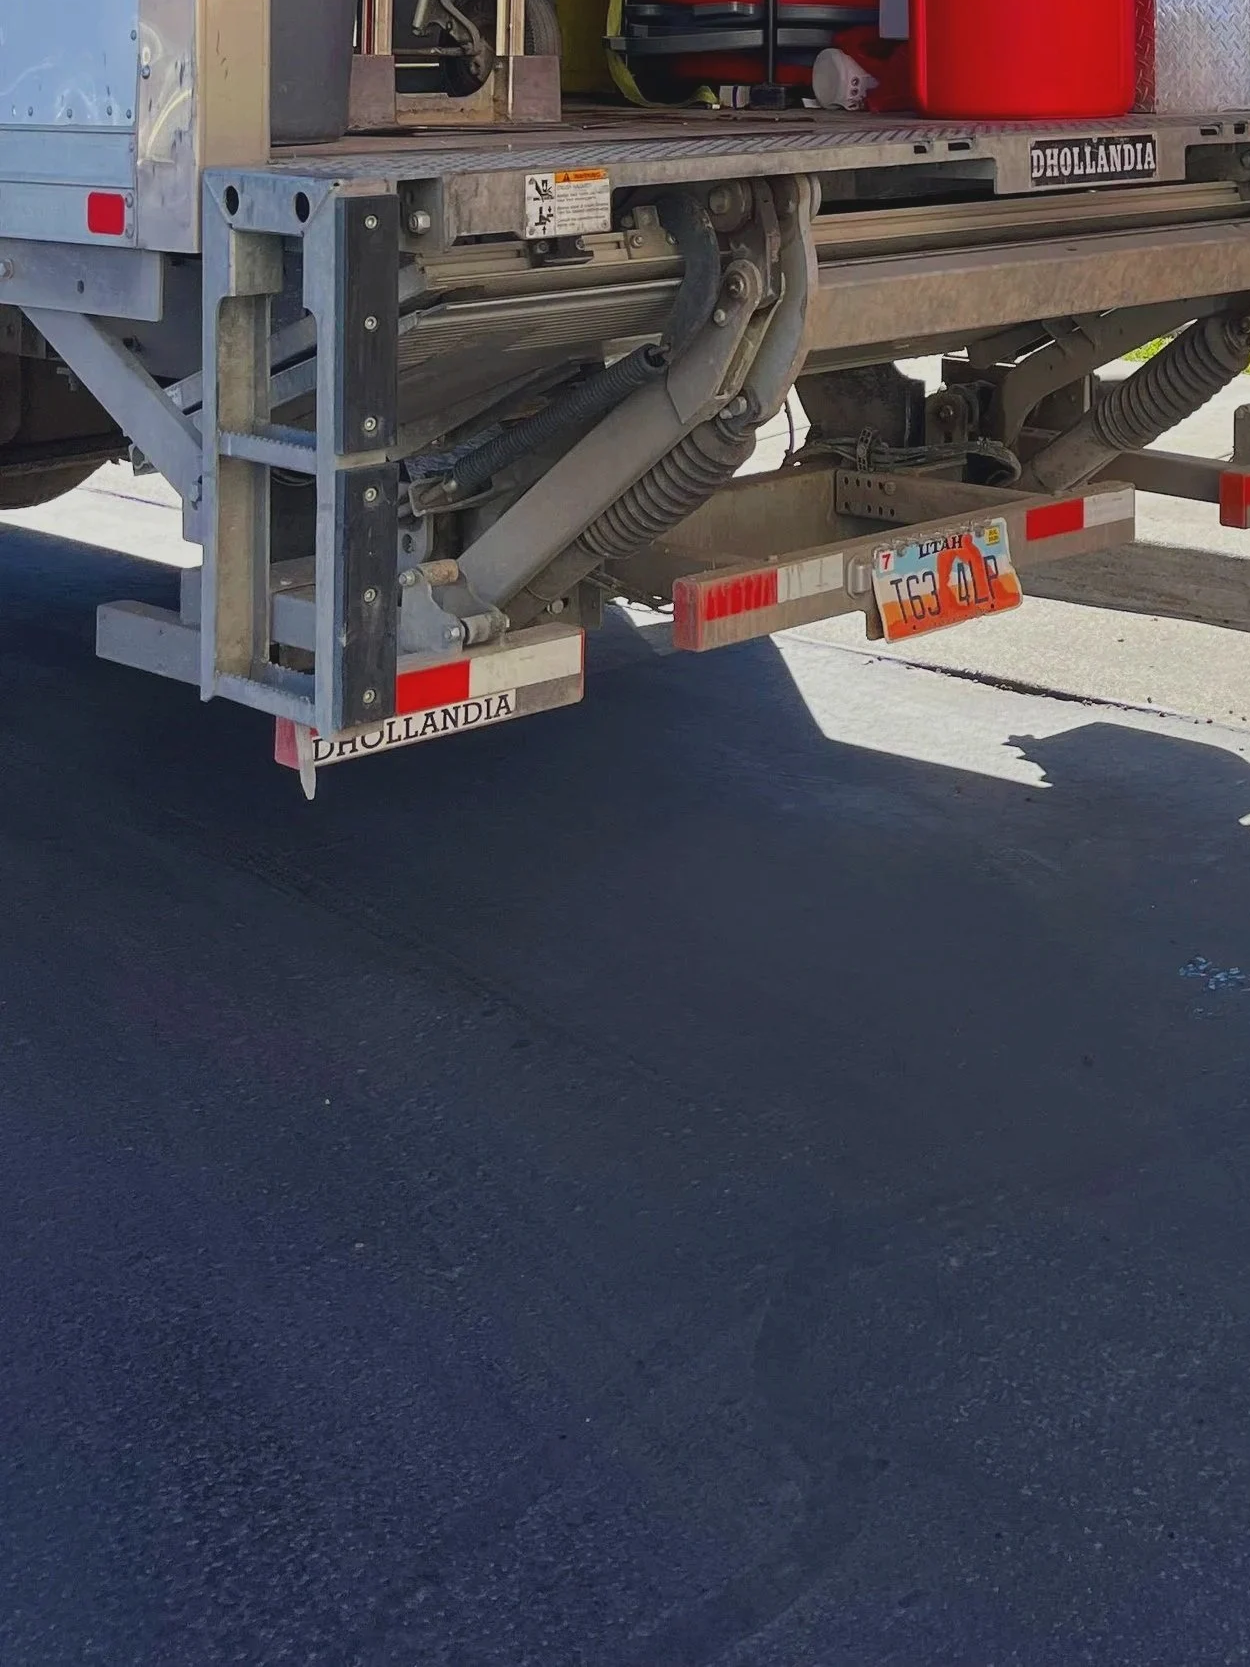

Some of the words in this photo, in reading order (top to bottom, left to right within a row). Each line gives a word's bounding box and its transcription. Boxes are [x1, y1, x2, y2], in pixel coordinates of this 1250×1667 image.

[1031, 142, 1156, 178] DHOLLANDIA
[881, 553, 892, 571] 7
[918, 534, 964, 559] UTAH
[890, 571, 941, 624] T63
[314, 694, 513, 762] DHOLLANDIA
